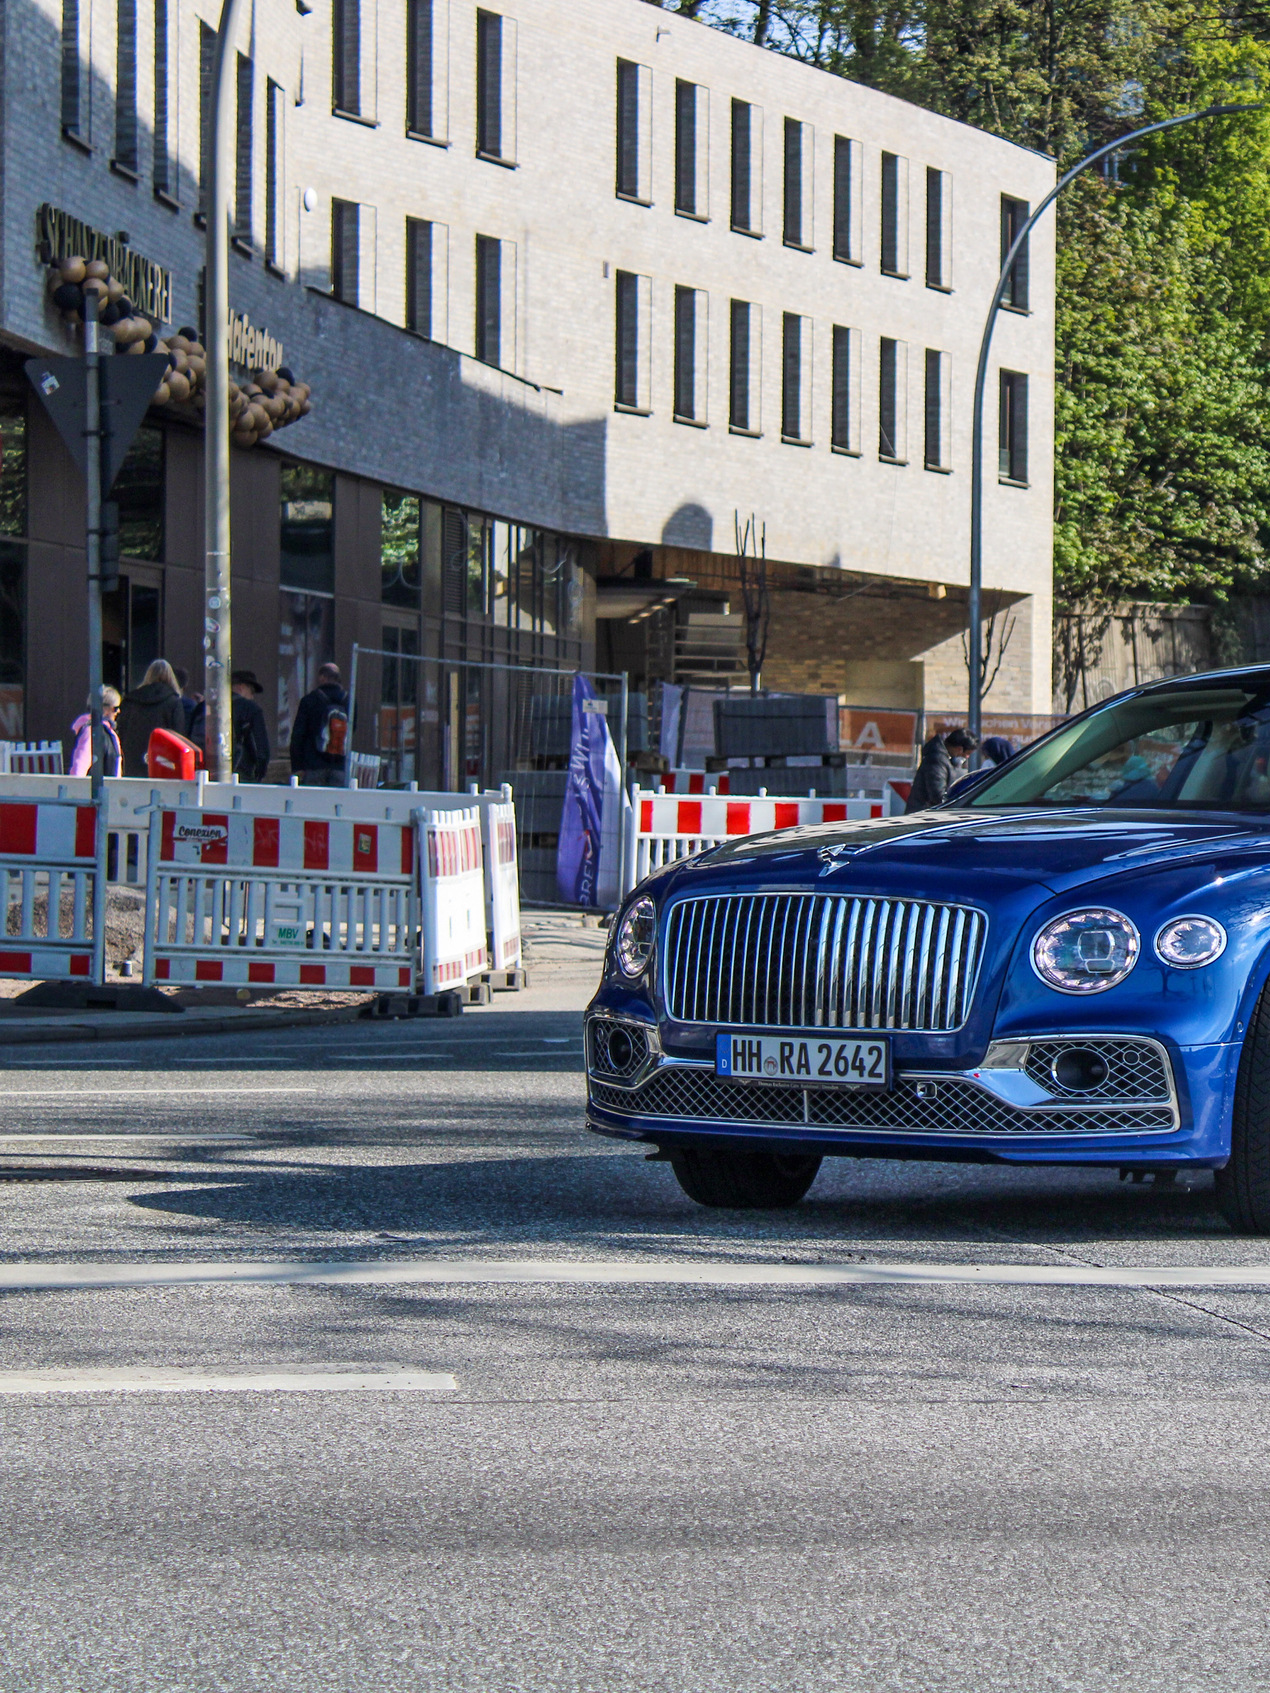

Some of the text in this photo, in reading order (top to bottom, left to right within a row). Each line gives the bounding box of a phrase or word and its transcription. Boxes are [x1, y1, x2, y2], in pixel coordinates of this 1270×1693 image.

[178, 825, 222, 839] Conexion
[278, 927, 299, 939] MBV
[721, 1058, 728, 1069] D
[733, 1039, 883, 1079] HH RA 2642
